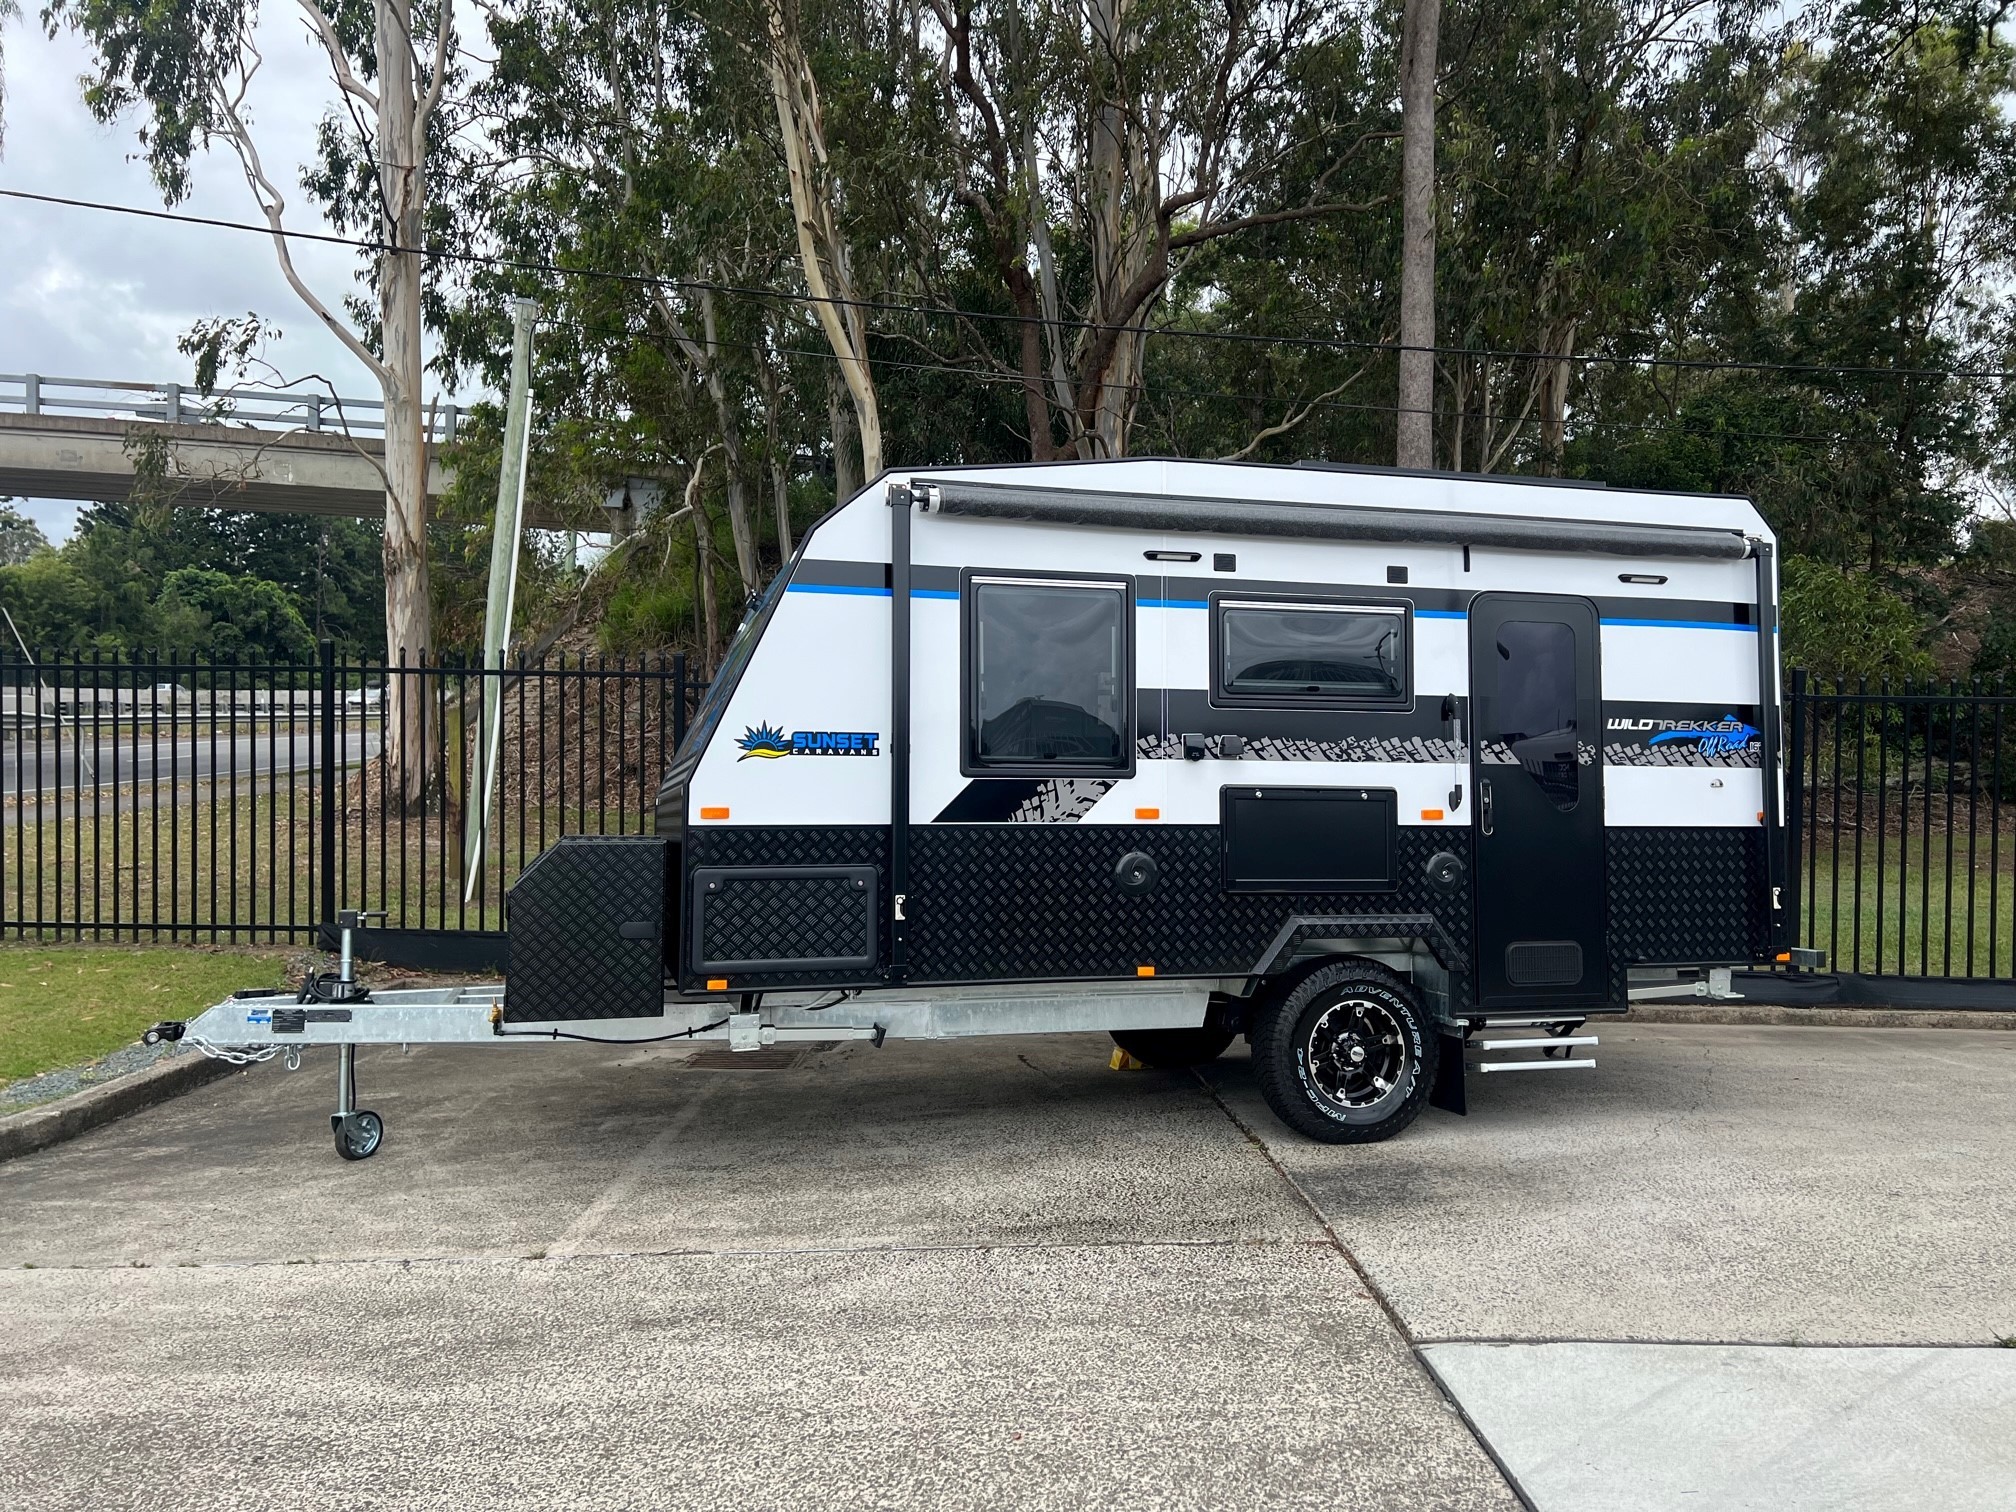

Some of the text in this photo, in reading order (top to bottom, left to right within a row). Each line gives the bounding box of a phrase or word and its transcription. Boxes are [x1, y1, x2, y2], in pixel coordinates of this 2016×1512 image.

[793, 732, 878, 748] SUNSET
[1340, 985, 1422, 1099] ADVENTURE A/T
